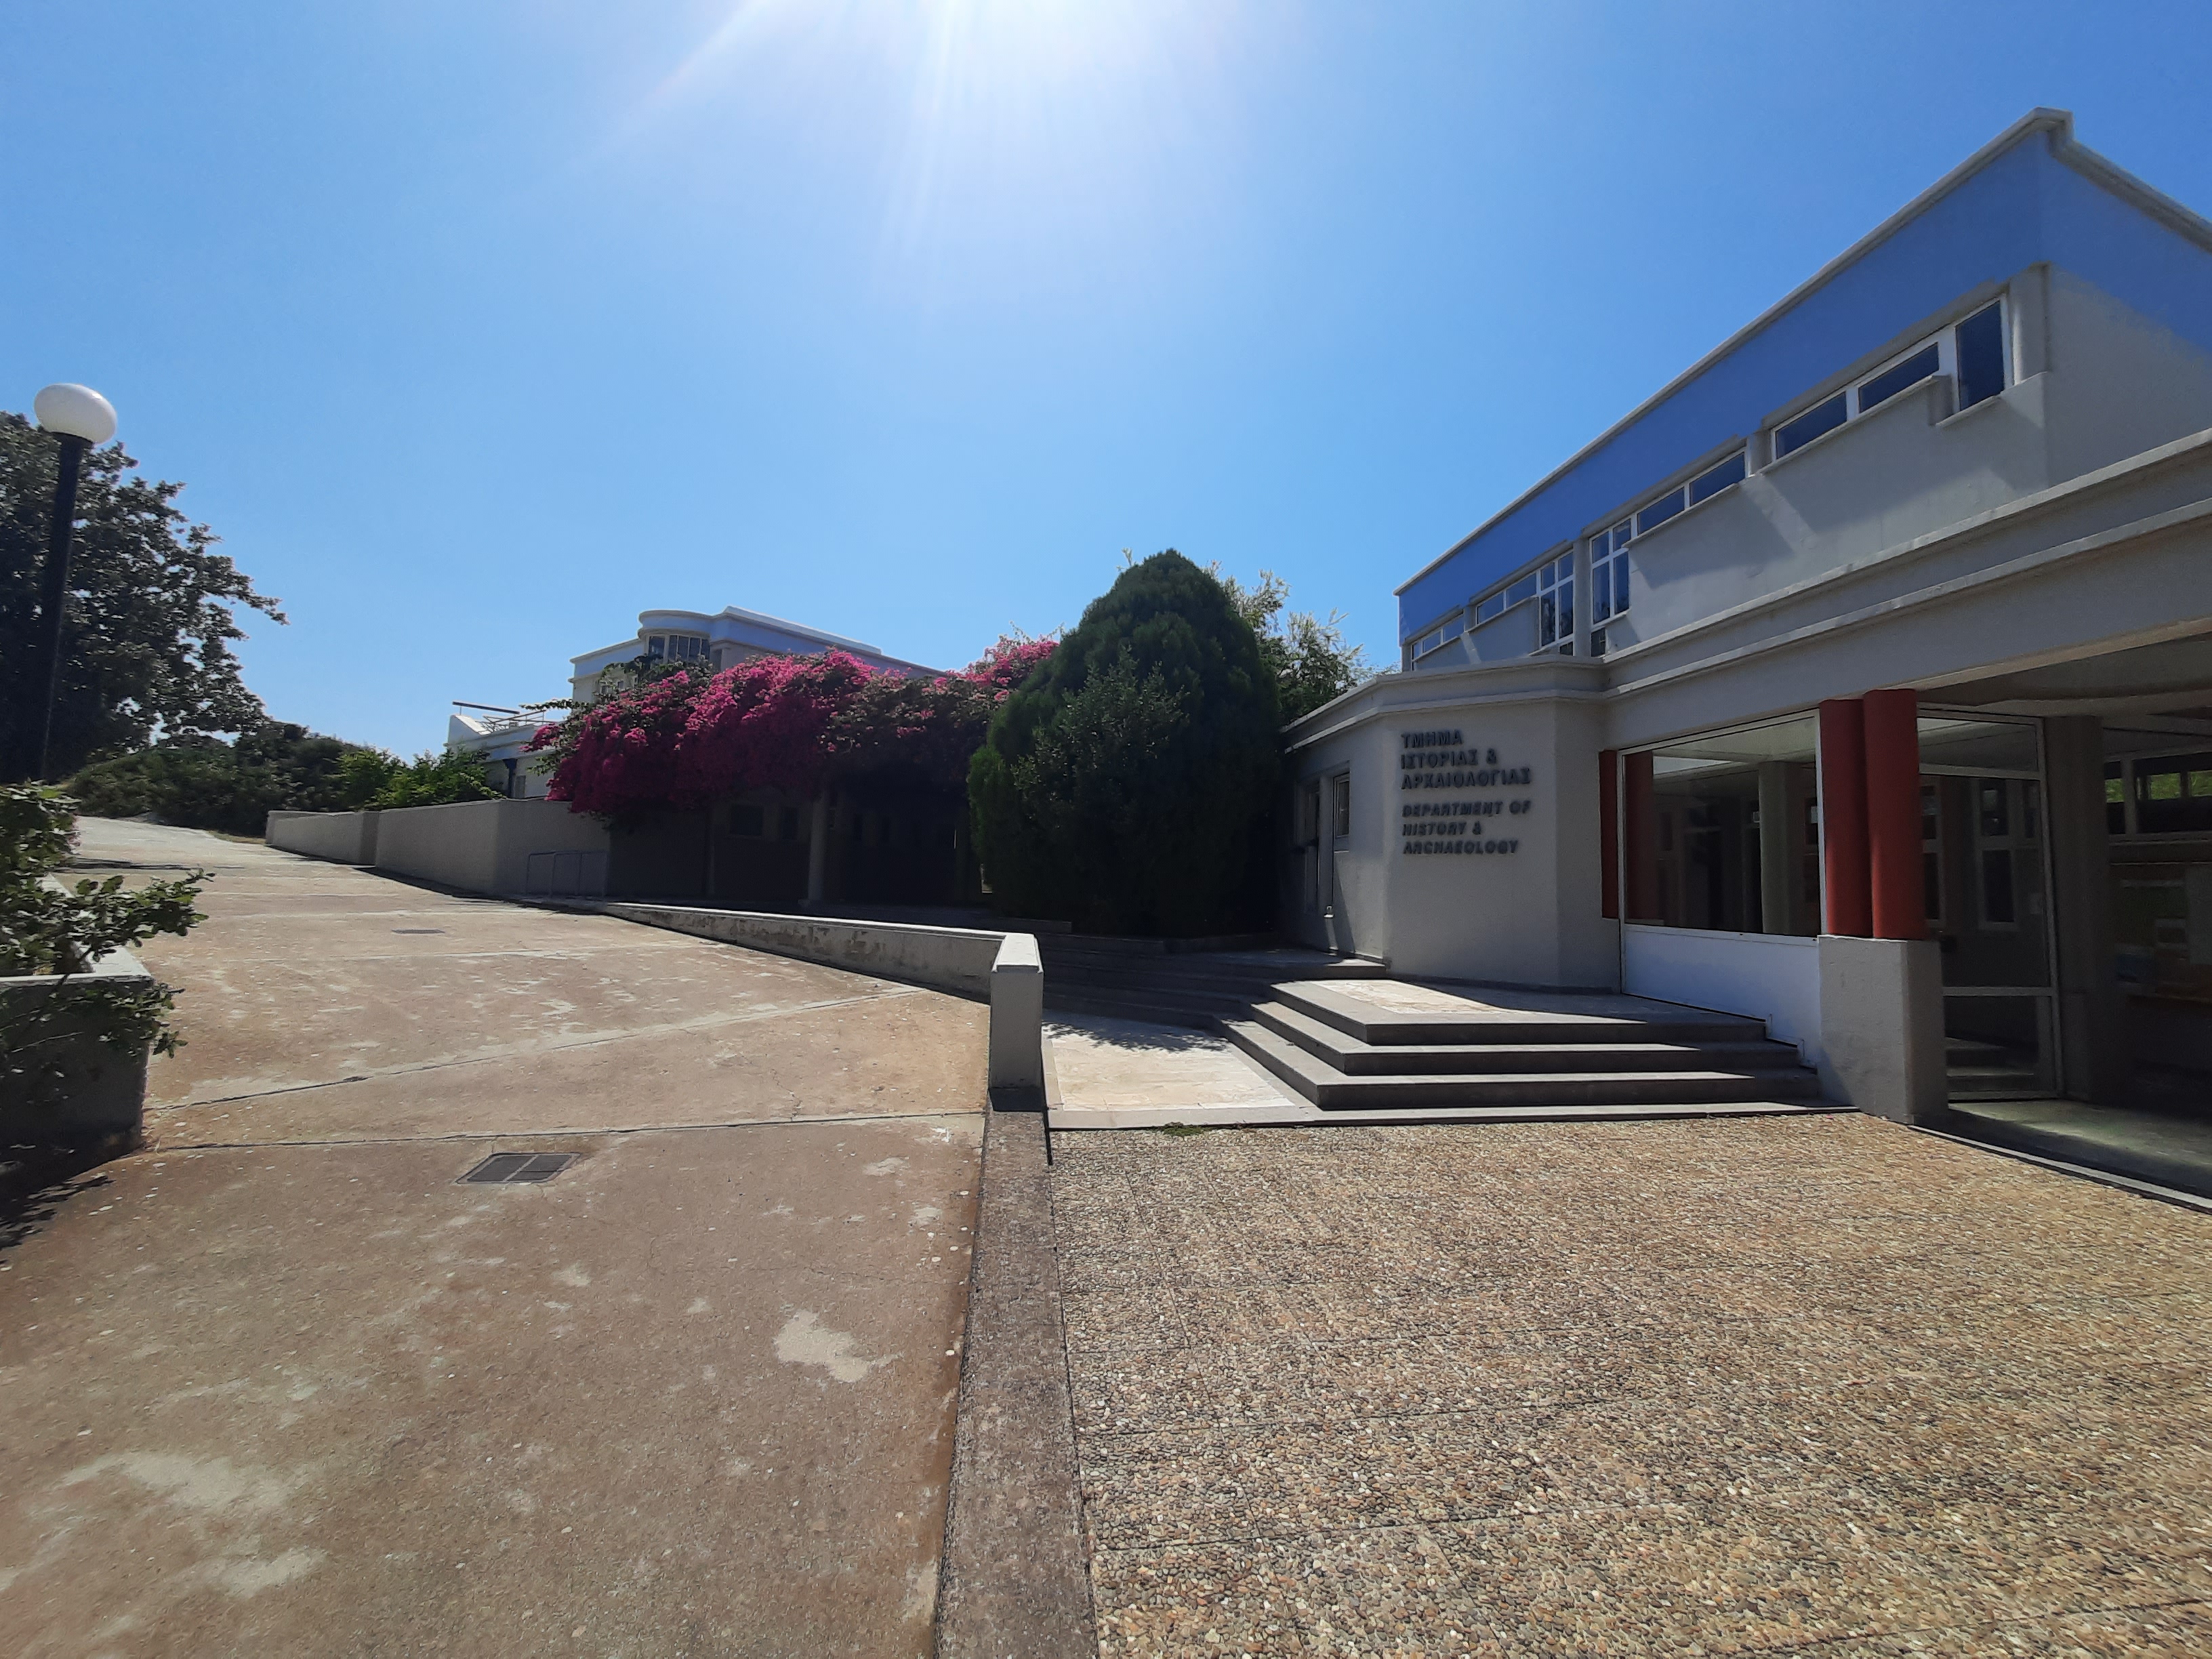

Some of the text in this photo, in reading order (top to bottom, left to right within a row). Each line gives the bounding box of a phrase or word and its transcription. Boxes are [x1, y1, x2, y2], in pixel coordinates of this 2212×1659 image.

[1401, 729, 1463, 748] ΤΜΗΜΑ
[1401, 748, 1497, 769] ΙΣΤΟΡΙΑΣ &
[1401, 767, 1530, 790] ΑΡΧΑΙΟΛΟΓΙΑΣ
[1402, 800, 1531, 817] DEPARTMENT OF
[1402, 821, 1481, 836] HISTORY &
[1403, 840, 1518, 854] ARCHAEOLOGY
